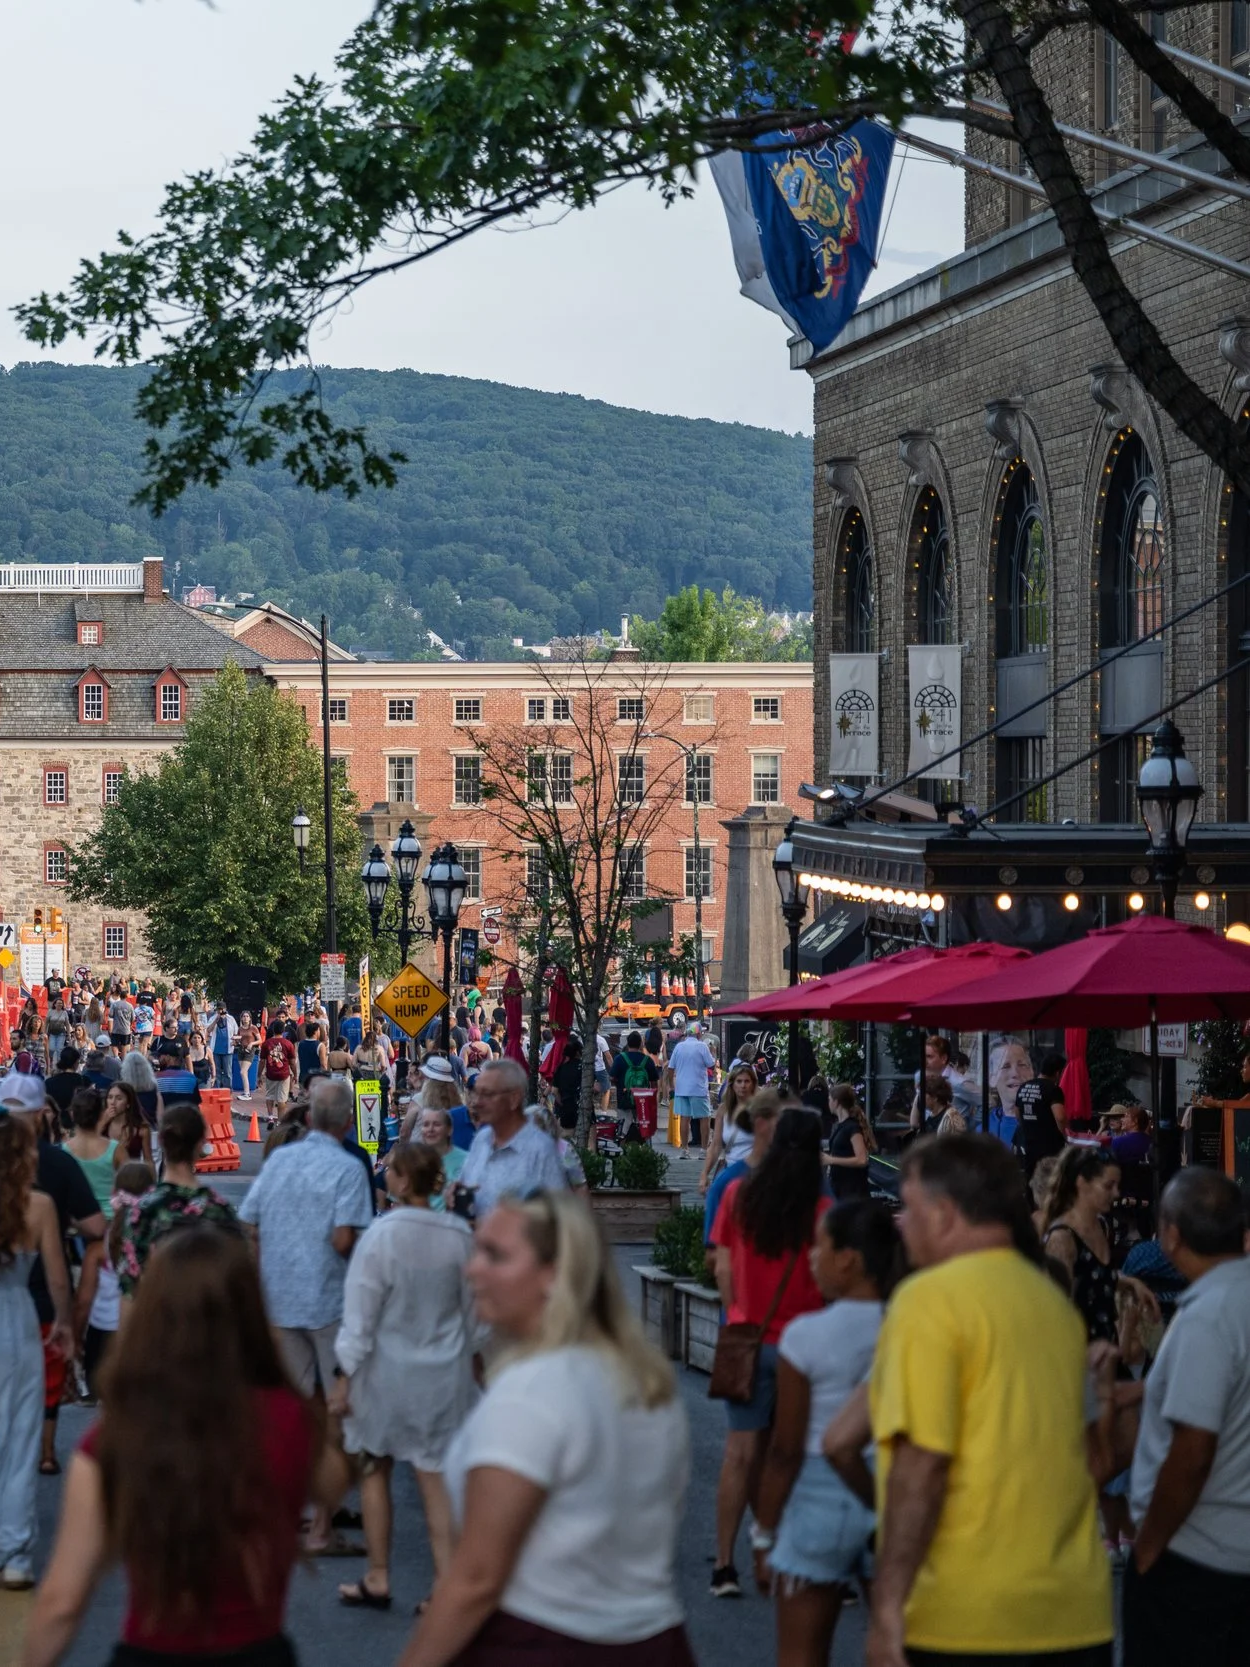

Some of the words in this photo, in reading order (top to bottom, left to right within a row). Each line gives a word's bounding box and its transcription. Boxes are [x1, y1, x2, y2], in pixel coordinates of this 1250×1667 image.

[392, 985, 430, 999] SPEED
[395, 1003, 428, 1018] HUMP
[1158, 1027, 1180, 1037] IDAY
